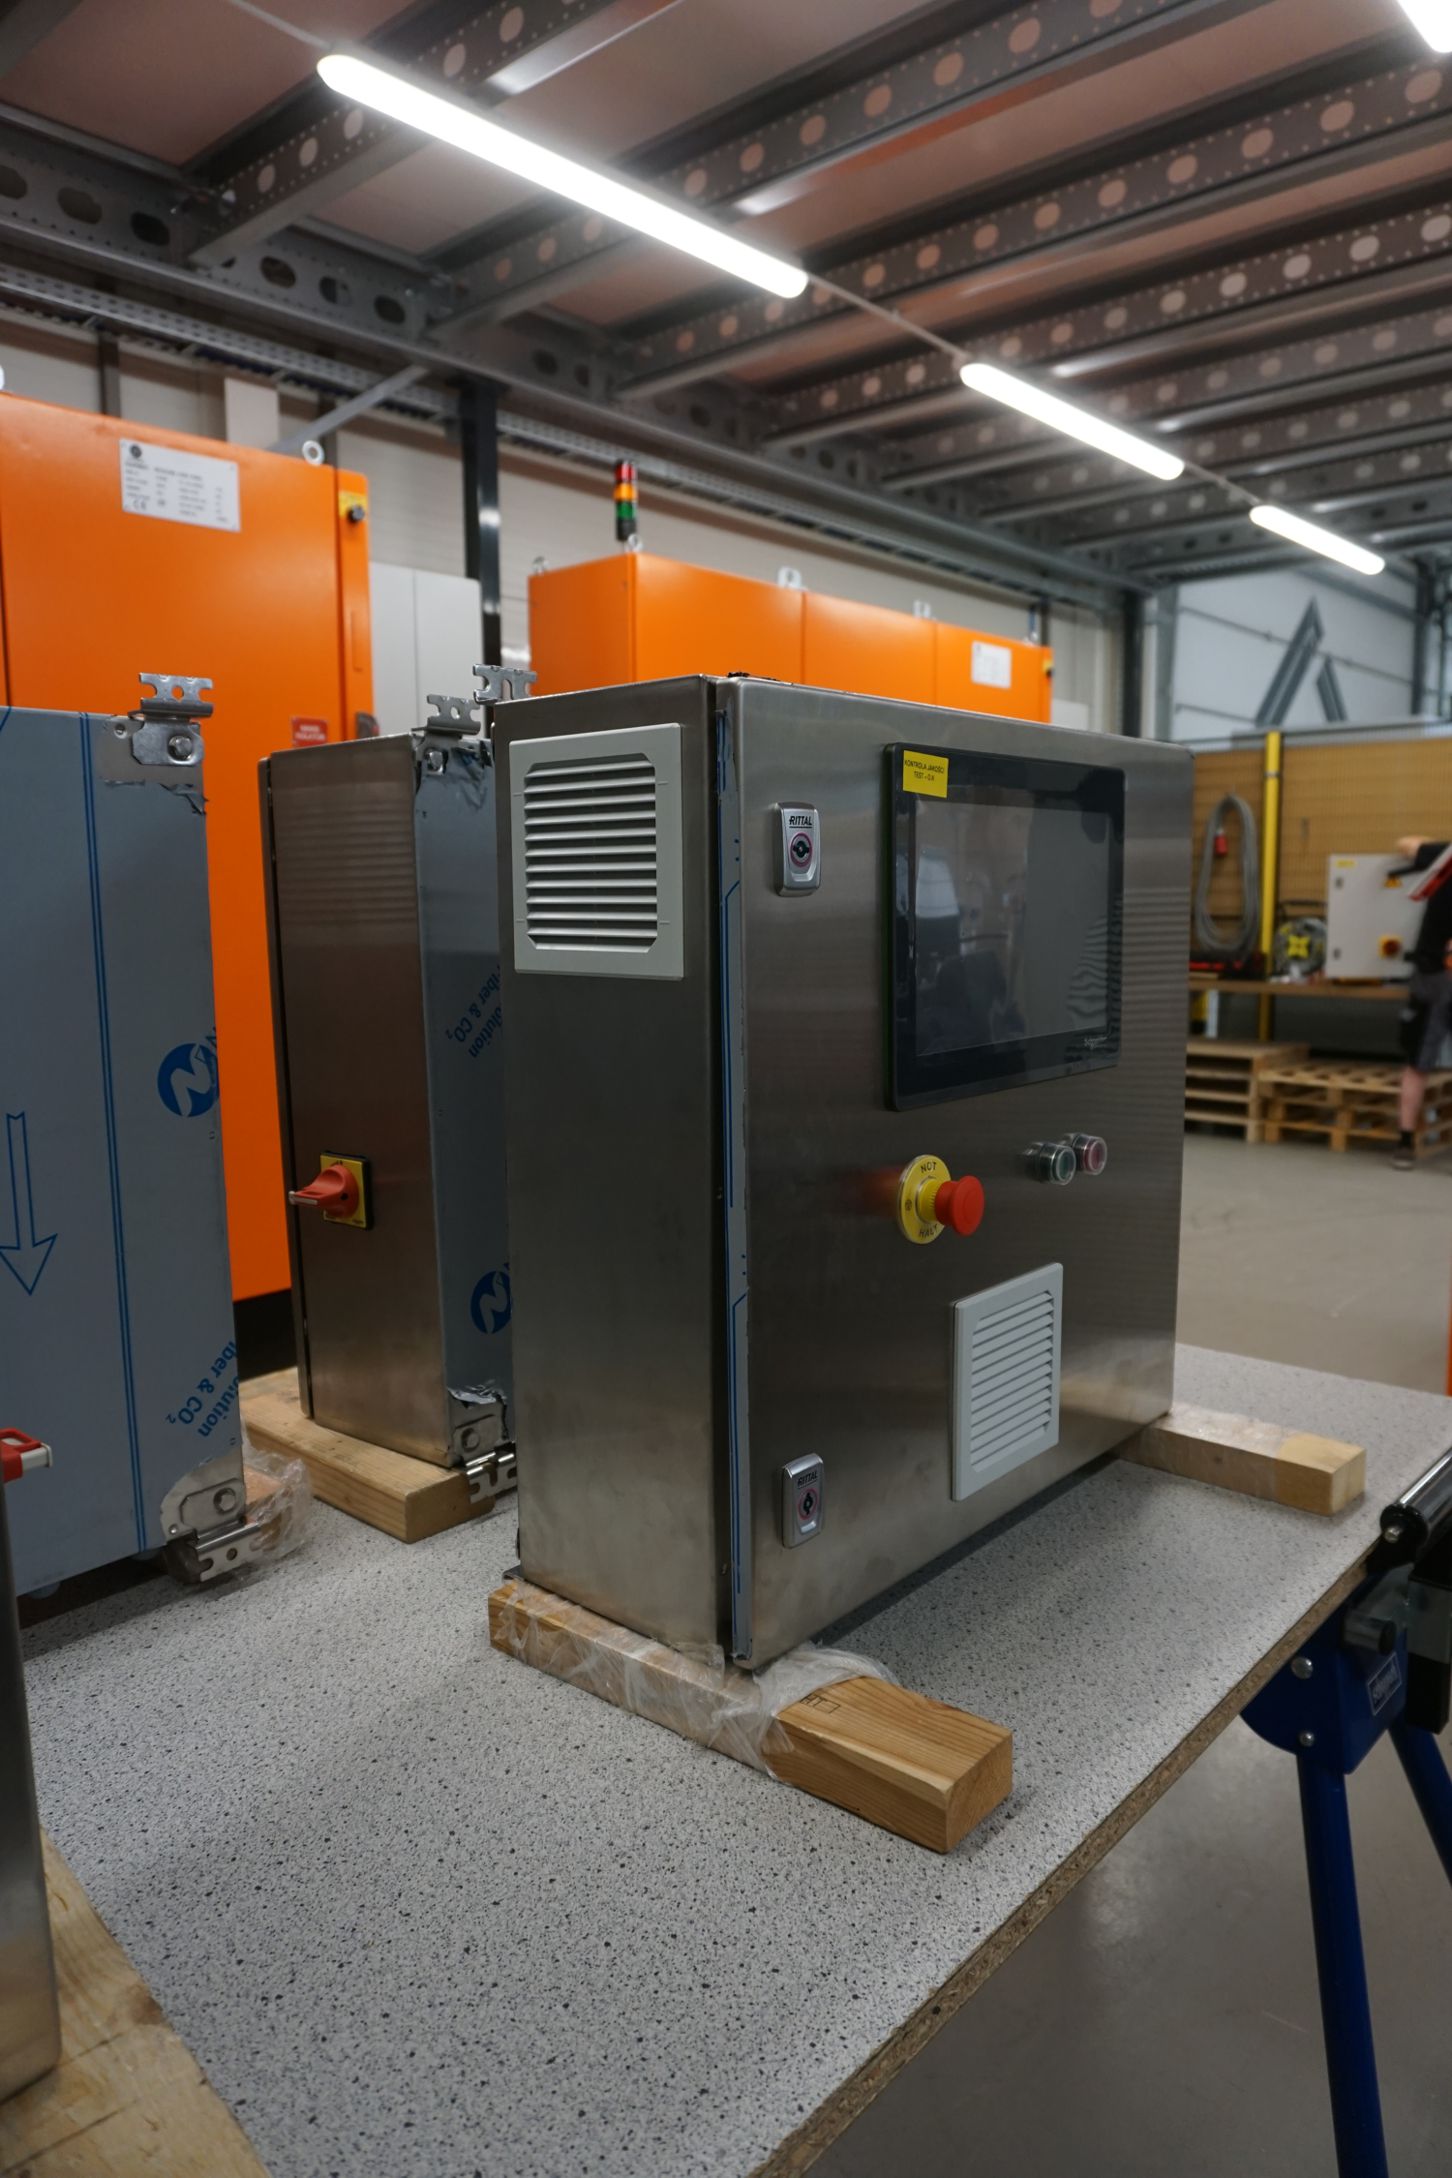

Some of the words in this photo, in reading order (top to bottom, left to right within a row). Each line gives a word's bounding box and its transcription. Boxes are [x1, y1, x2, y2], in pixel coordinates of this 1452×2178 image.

[789, 815, 813, 826] RITTAL
[468, 1002, 481, 1018] &
[920, 1161, 937, 1174] NOT
[196, 1378, 215, 1394] &
[797, 1470, 818, 1488] RITTAL
